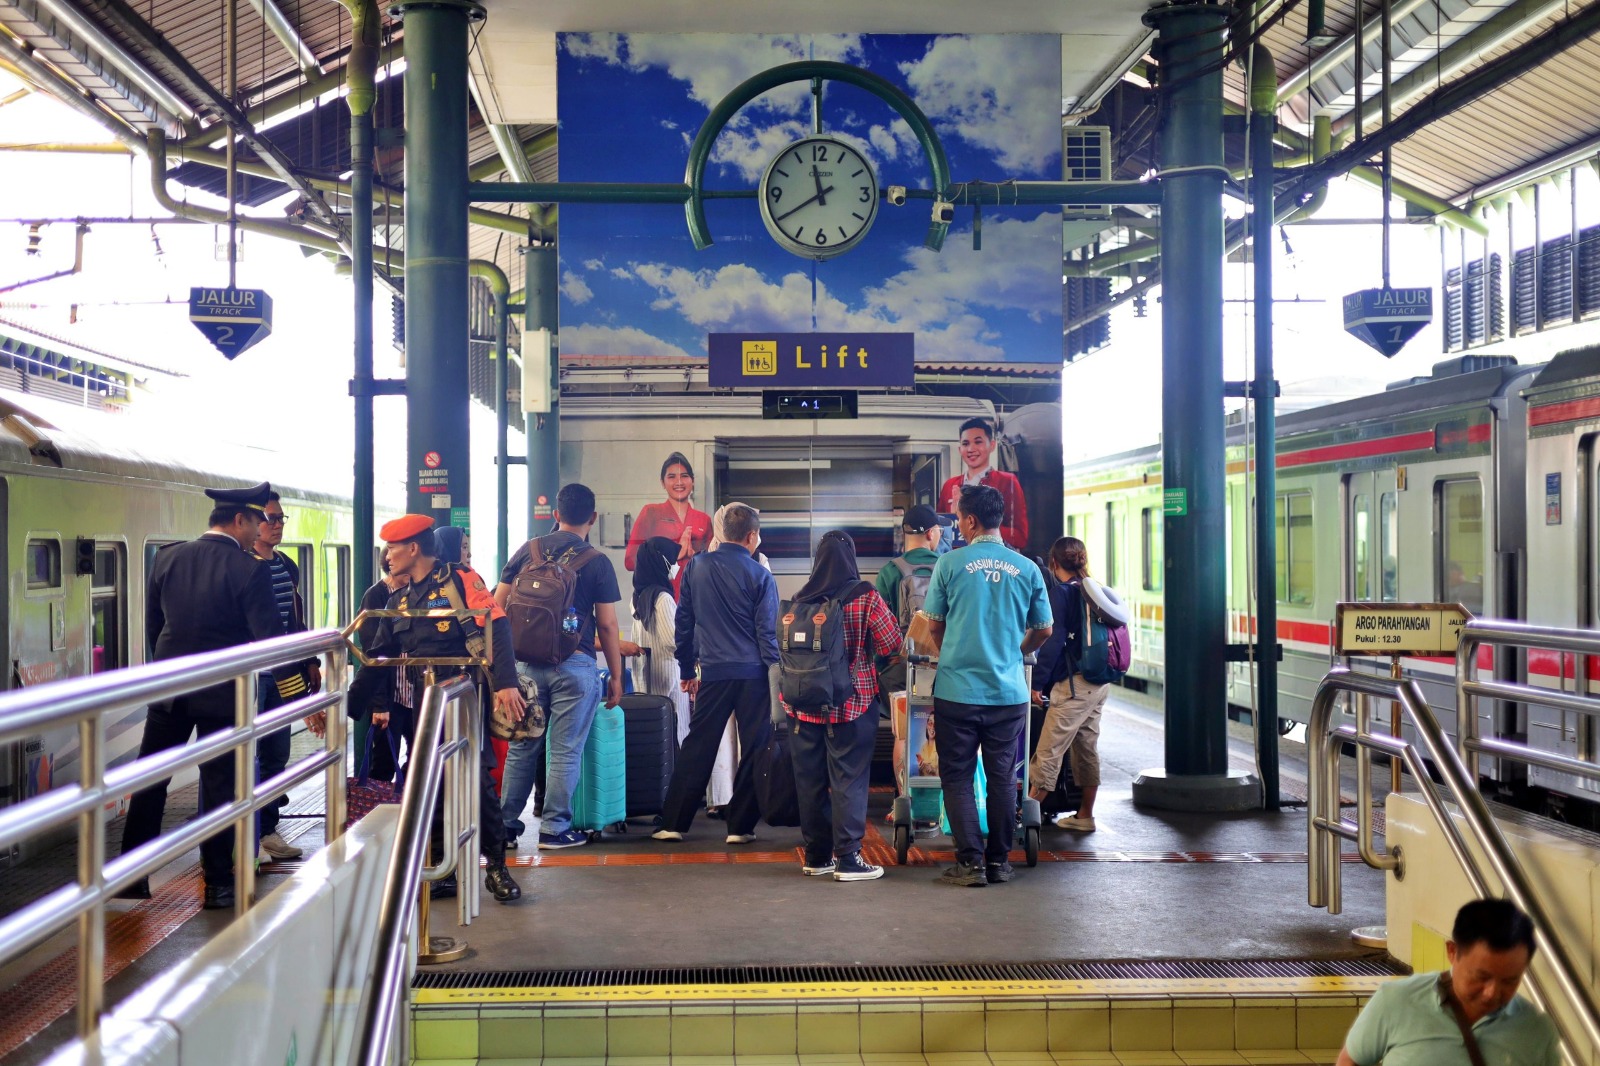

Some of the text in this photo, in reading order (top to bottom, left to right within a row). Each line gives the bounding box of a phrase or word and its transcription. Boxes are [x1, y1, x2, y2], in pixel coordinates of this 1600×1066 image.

[812, 145, 828, 162] 12
[771, 186, 782, 203] 9
[859, 186, 871, 203] 3
[815, 228, 827, 245] 6
[197, 289, 256, 306] JALUR
[1373, 290, 1429, 306] JALUR
[209, 307, 242, 316] TRACK
[1385, 307, 1417, 316] TRACK
[216, 325, 236, 346] 2
[1386, 325, 1404, 344] 1
[796, 344, 868, 369] Lift
[813, 400, 820, 410] 1
[965, 558, 1021, 578] STASIUN GAMBIR
[985, 569, 1001, 583] 70
[1355, 615, 1431, 631] ARGO PARAHYANGAN
[1355, 634, 1376, 643] Pukul
[1382, 635, 1402, 644] 12.30
